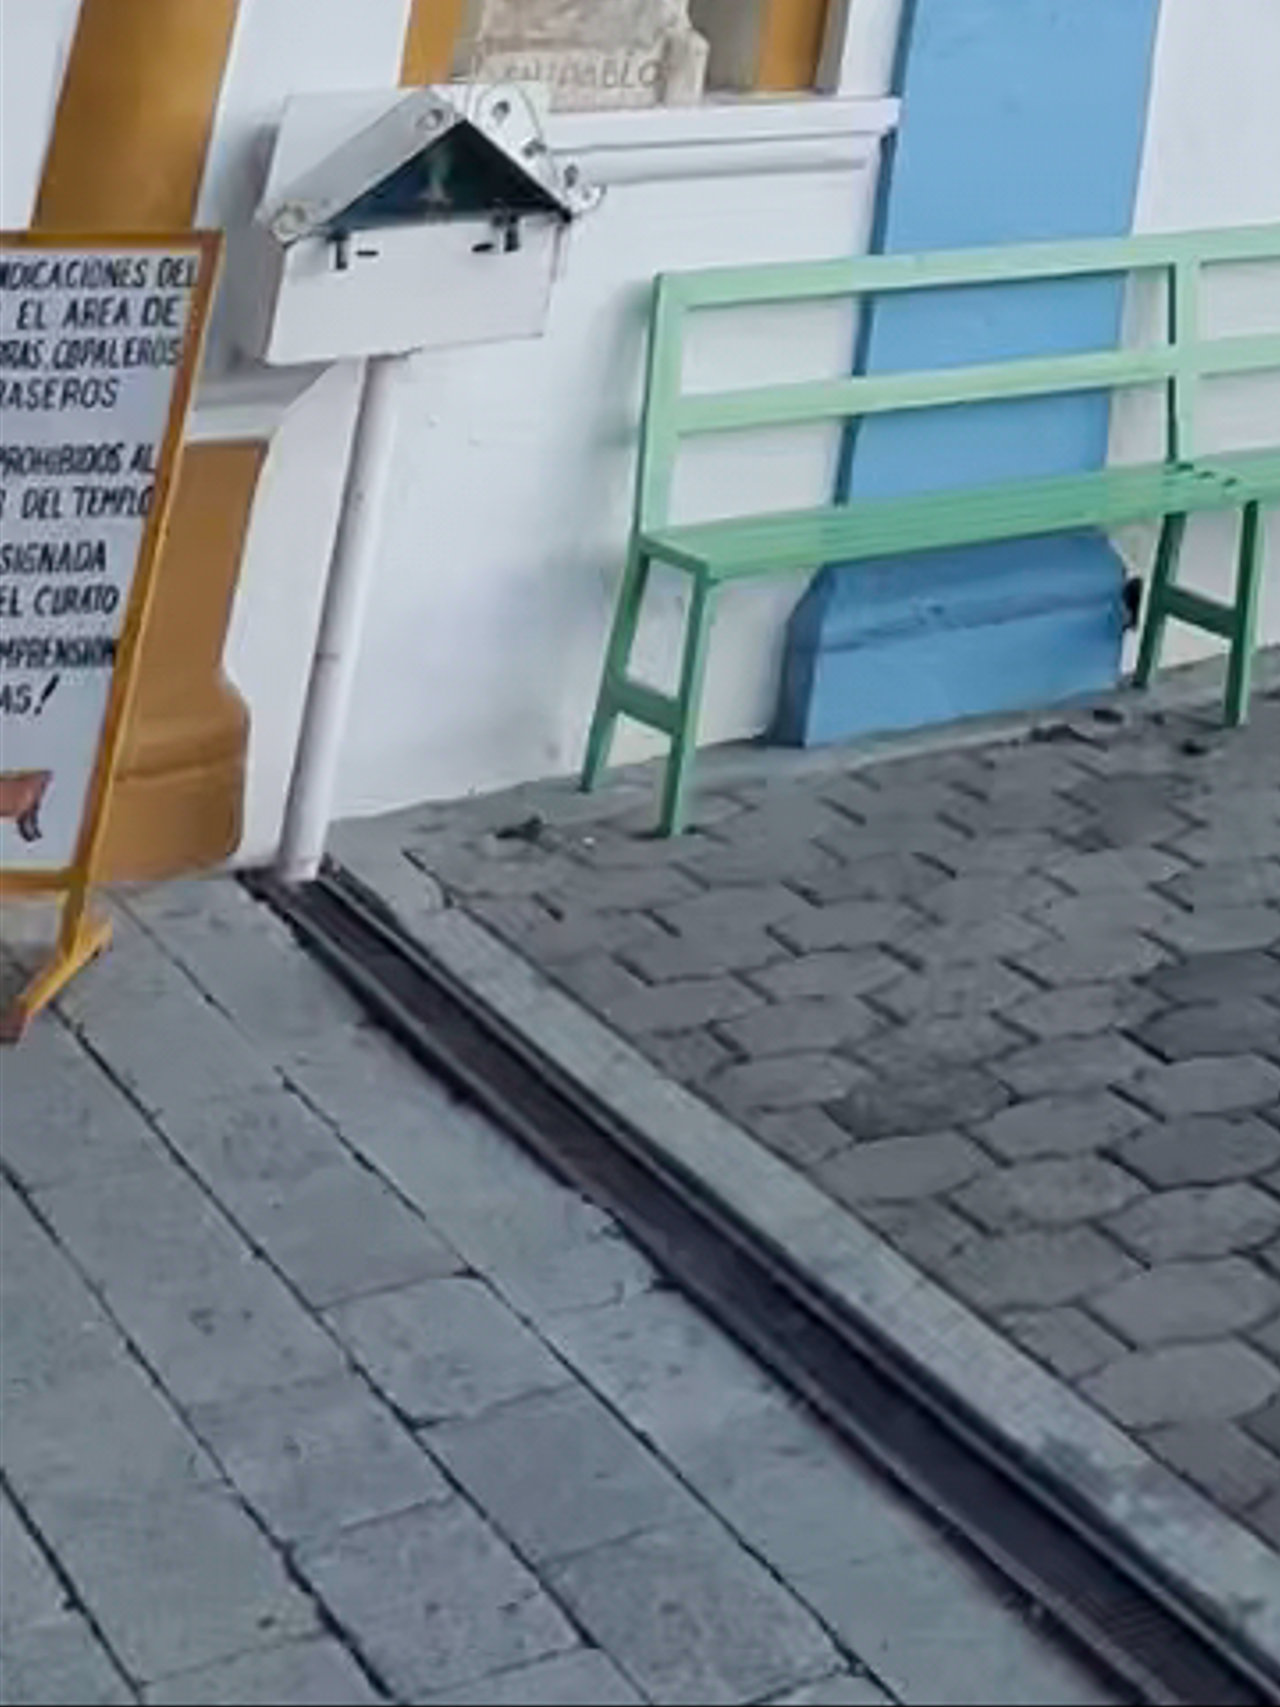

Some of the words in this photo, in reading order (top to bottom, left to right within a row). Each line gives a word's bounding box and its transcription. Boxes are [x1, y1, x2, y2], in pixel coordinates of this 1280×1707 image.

[157, 257, 198, 288] DEL
[16, 299, 47, 330] EL
[62, 296, 131, 329] AREA
[141, 296, 179, 327] DE
[130, 444, 155, 473] AL
[21, 487, 62, 519] DEL
[33, 584, 120, 617] CURATO
